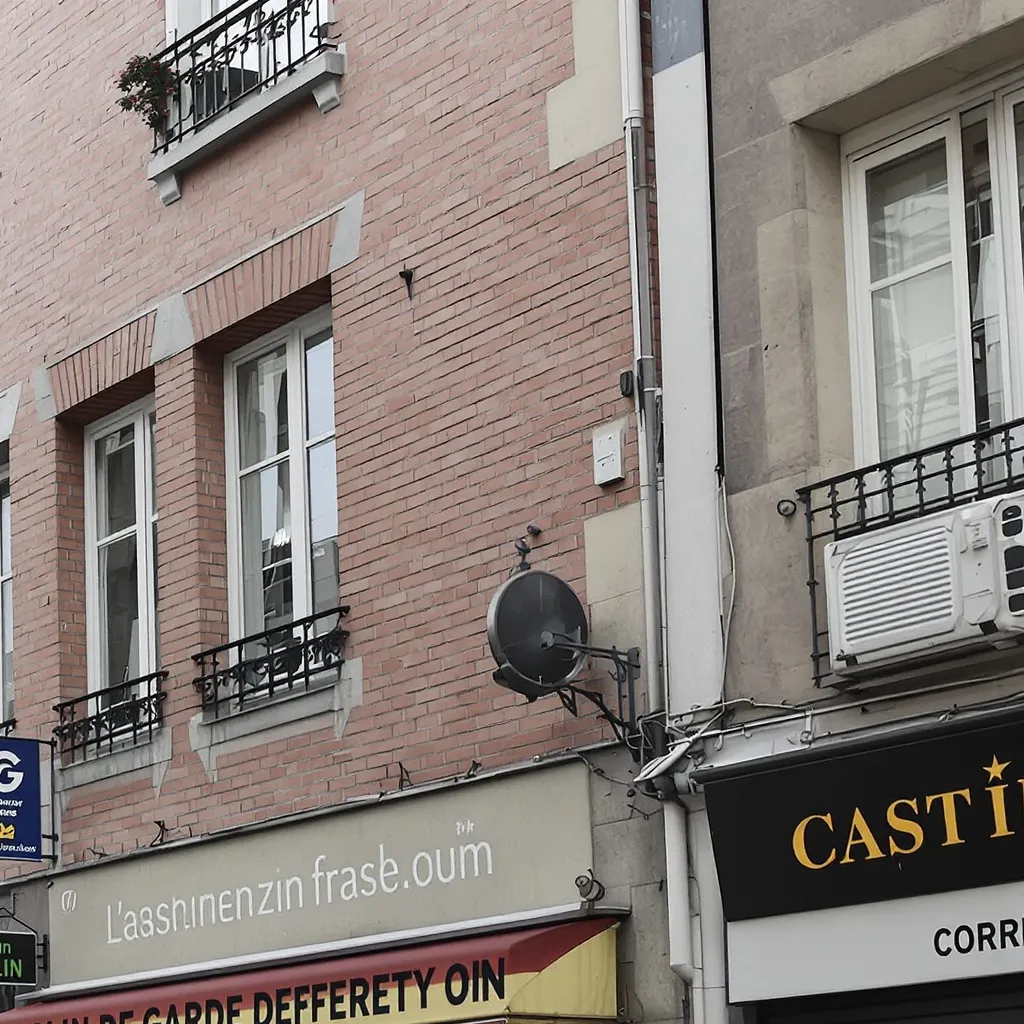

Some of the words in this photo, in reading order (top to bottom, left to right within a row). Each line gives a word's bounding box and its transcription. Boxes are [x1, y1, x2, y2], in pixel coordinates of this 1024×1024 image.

[792, 777, 1024, 870] CASTI
[933, 917, 1024, 957] CORR
[444, 957, 506, 1006] OIN
